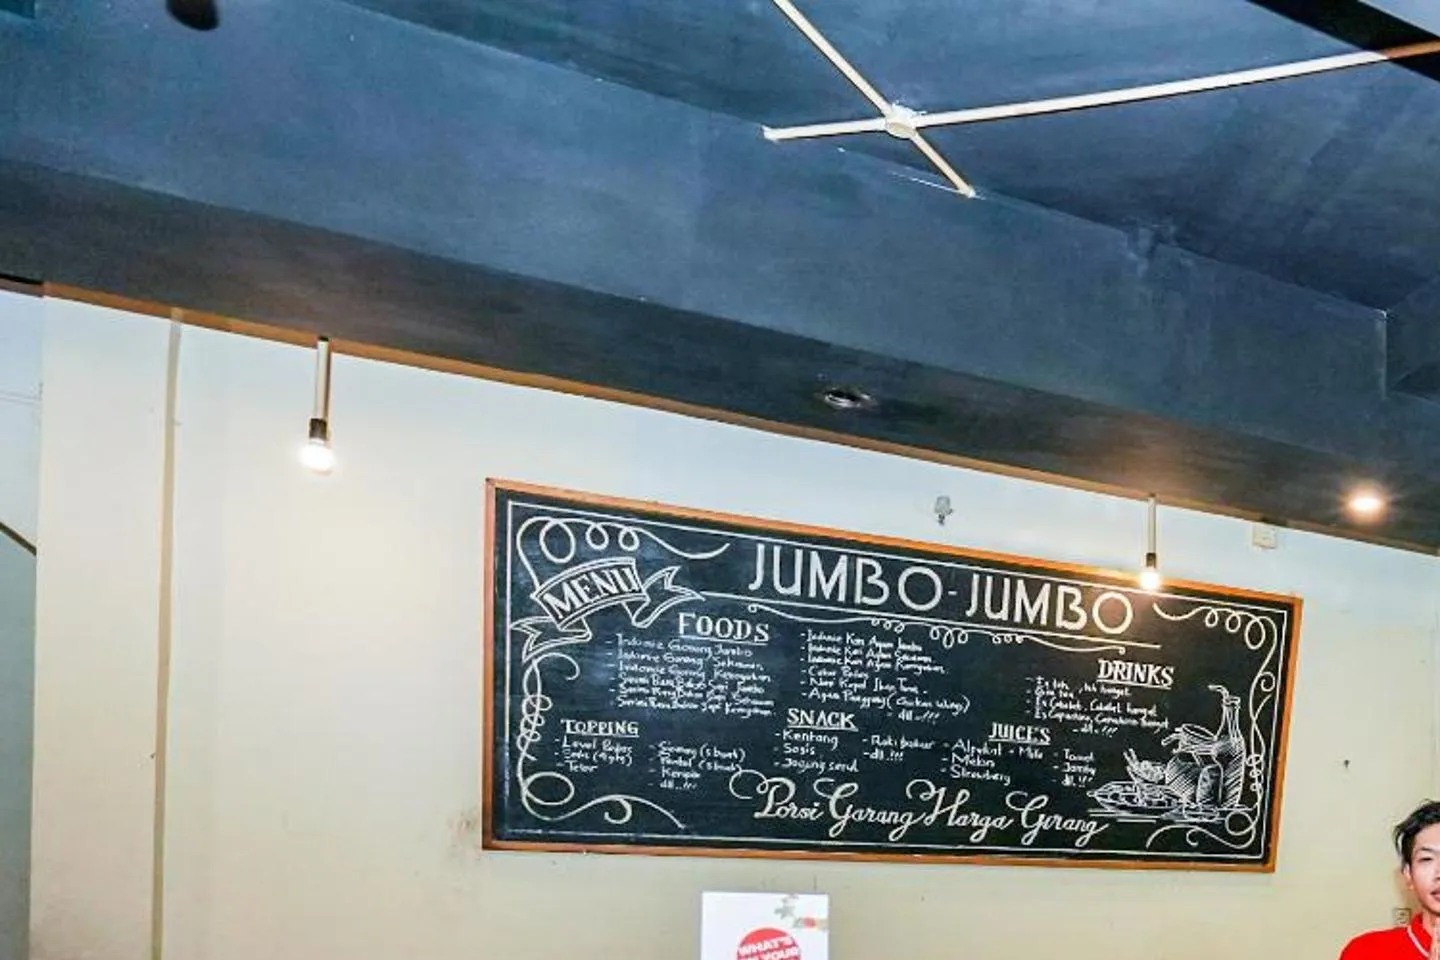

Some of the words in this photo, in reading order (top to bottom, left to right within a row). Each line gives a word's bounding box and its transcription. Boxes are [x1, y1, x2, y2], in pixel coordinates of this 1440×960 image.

[543, 567, 640, 620] MENU
[678, 612, 769, 643] FOODS
[1097, 659, 1174, 687] DRINKS
[560, 718, 639, 735] TOPPING
[787, 708, 857, 730] SNACK
[782, 729, 838, 751] Kentang
[989, 723, 1051, 743] JUICES
[730, 769, 824, 820] Porsi
[813, 777, 924, 842] Garang
[906, 779, 1014, 843] Harga
